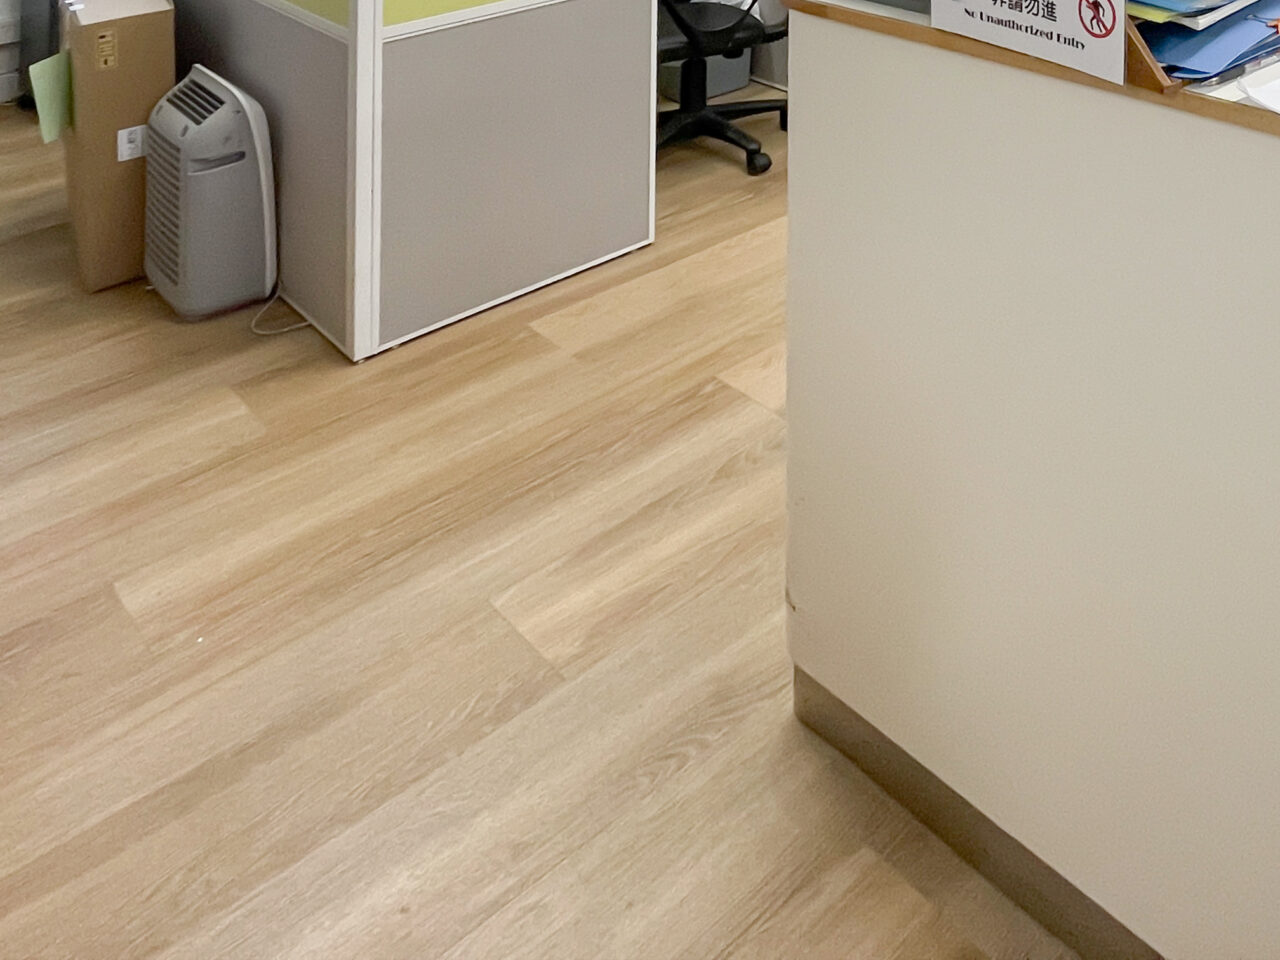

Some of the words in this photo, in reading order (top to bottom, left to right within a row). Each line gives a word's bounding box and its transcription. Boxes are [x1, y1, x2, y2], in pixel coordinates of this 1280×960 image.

[964, 7, 978, 19] No
[979, 11, 1054, 41] Unauthorized
[1056, 33, 1085, 51] Entry
